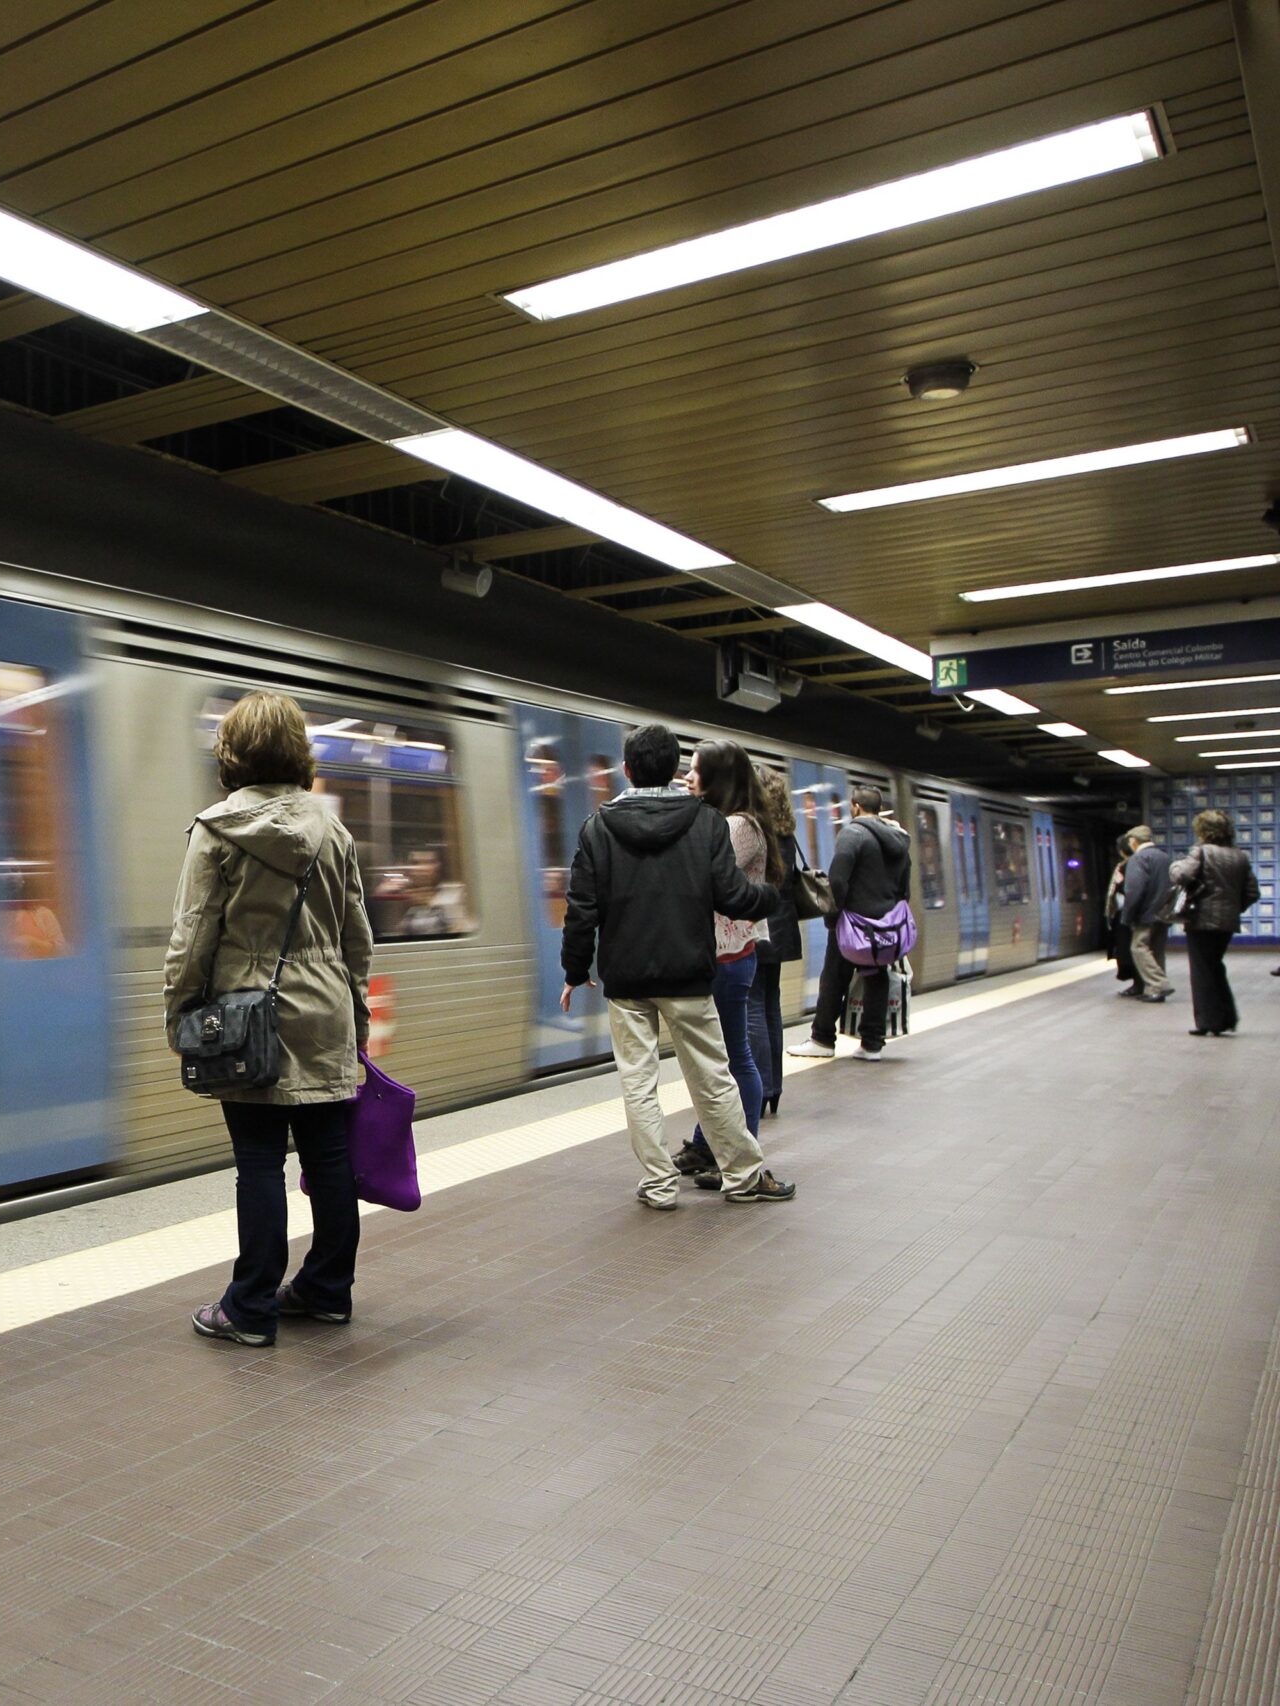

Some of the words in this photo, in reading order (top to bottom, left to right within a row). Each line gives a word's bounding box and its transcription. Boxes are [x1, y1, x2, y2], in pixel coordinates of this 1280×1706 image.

[1113, 651, 1141, 661] Centro
[1142, 646, 1183, 658] Comercial
[1185, 643, 1224, 654] Colombo
[1113, 660, 1146, 670] Avenida
[1148, 658, 1159, 666] do
[1195, 652, 1223, 661] Militar
